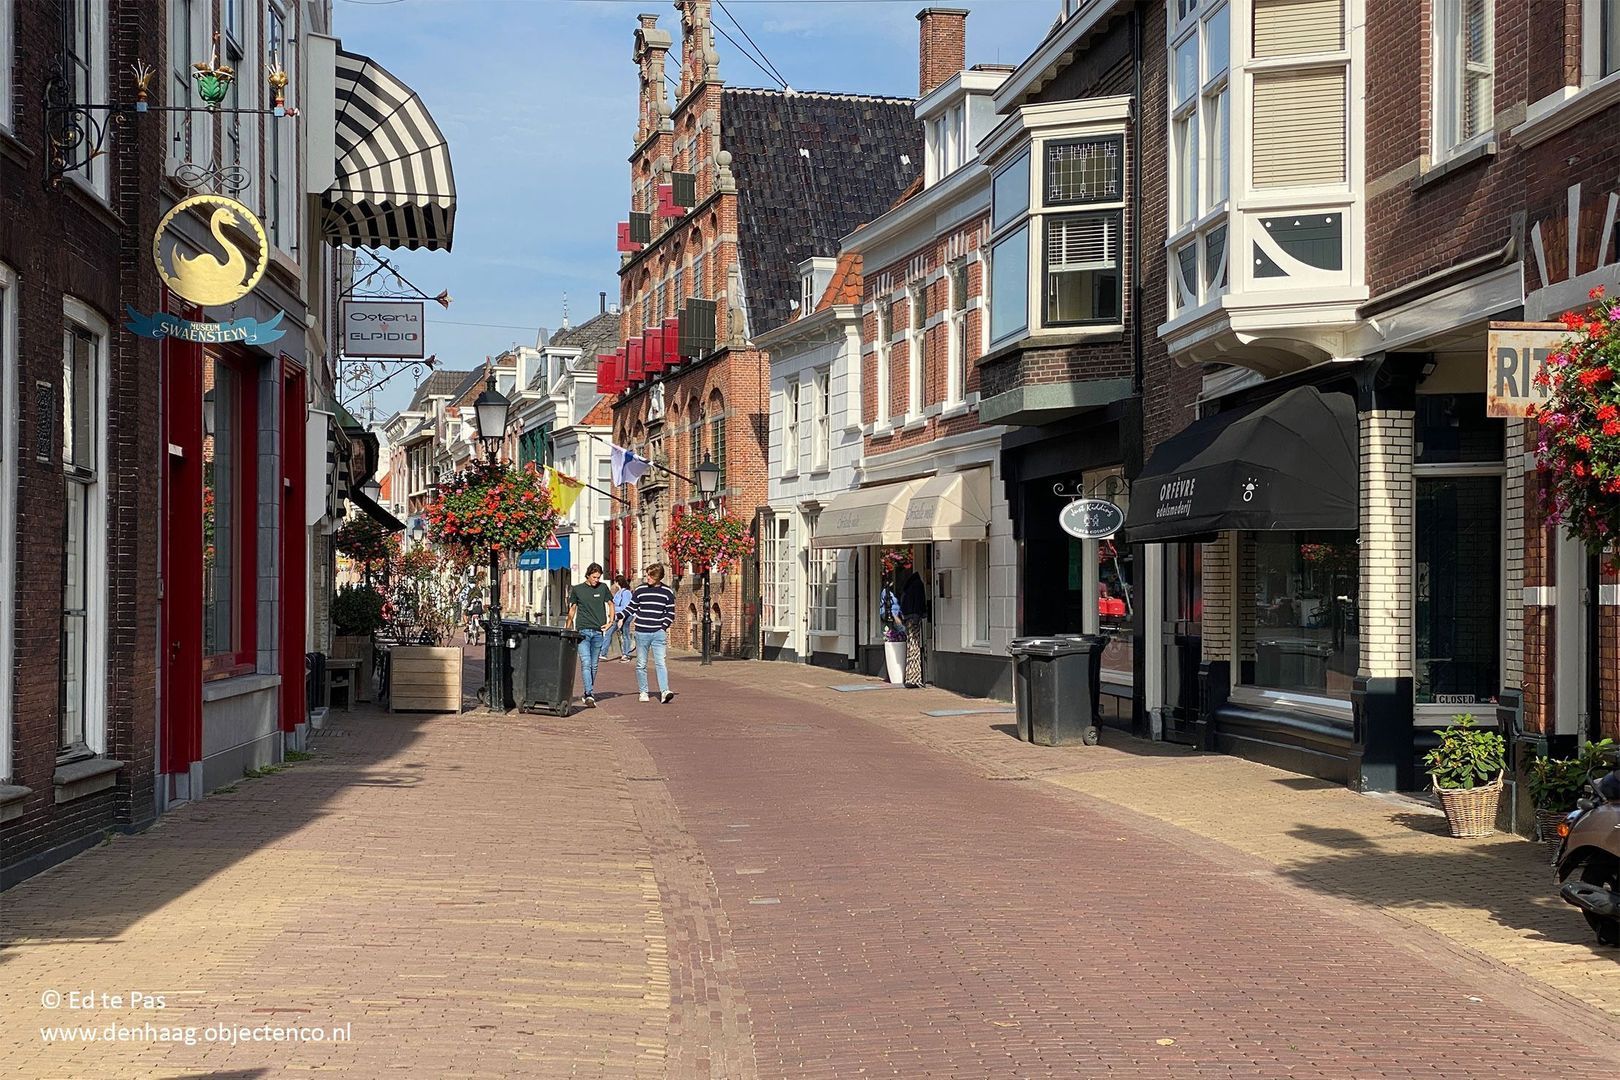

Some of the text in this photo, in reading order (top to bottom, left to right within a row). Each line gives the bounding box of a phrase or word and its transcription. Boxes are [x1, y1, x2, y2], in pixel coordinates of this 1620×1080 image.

[350, 312, 418, 322] Osteria
[160, 321, 248, 343] SWAENSTEYN
[189, 322, 221, 332] MUSEUM
[350, 332, 418, 341] ELPIDIO
[1159, 476, 1196, 501] ORFÈVRE
[1086, 503, 1114, 517] Kidding
[1156, 499, 1192, 518] edelsmederij
[1439, 695, 1474, 704] CLOSED
